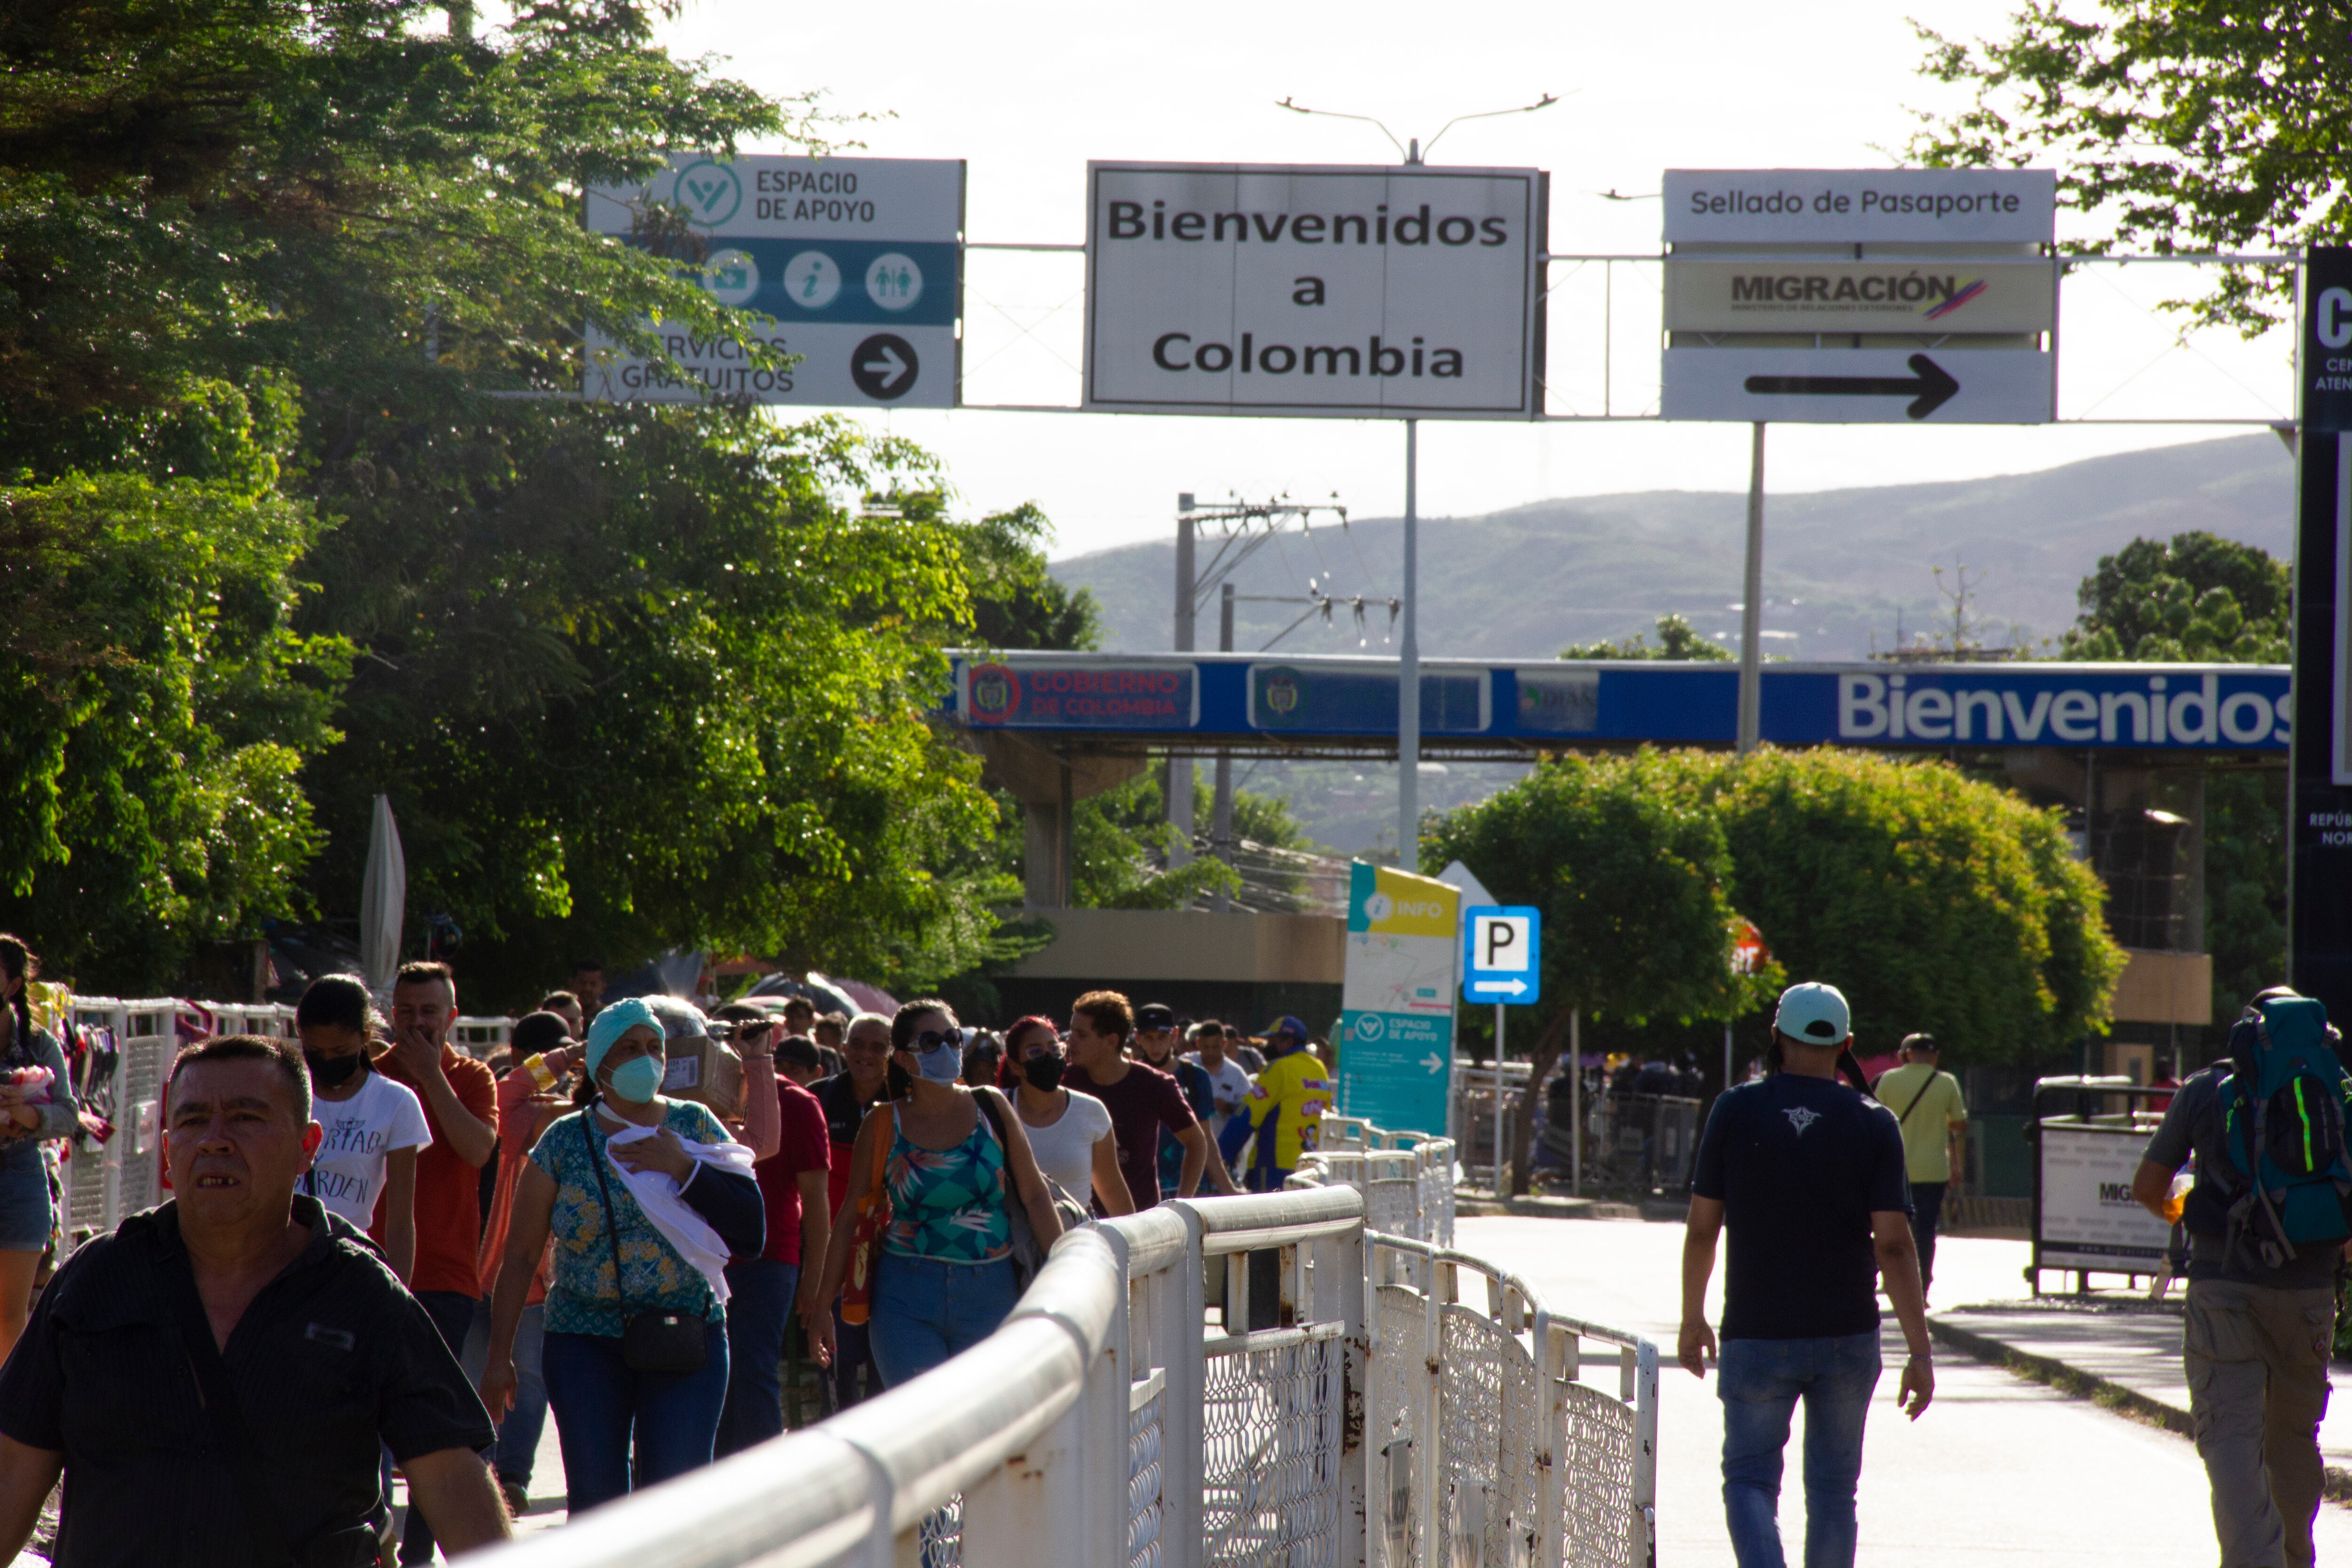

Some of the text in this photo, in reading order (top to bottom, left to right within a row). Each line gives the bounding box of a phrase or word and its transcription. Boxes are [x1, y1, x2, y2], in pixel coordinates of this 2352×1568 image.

[757, 170, 857, 194] ESPACIO
[757, 198, 875, 222] DE APOYO
[1691, 191, 2020, 219] Sellado de Pasaporte
[1108, 200, 1507, 247] Bienvenidos
[1292, 275, 1325, 306] a
[1732, 270, 1955, 302] MIGRACIÓN
[1152, 332, 1463, 377] Colombia
[1031, 671, 1178, 693] GOBIERNO
[1032, 697, 1176, 716] DE COLOMBIA
[1398, 901, 1442, 918] INFO
[1487, 921, 1515, 965] P
[324, 1127, 381, 1154] RTAD
[2099, 1182, 2133, 1201] MIG
